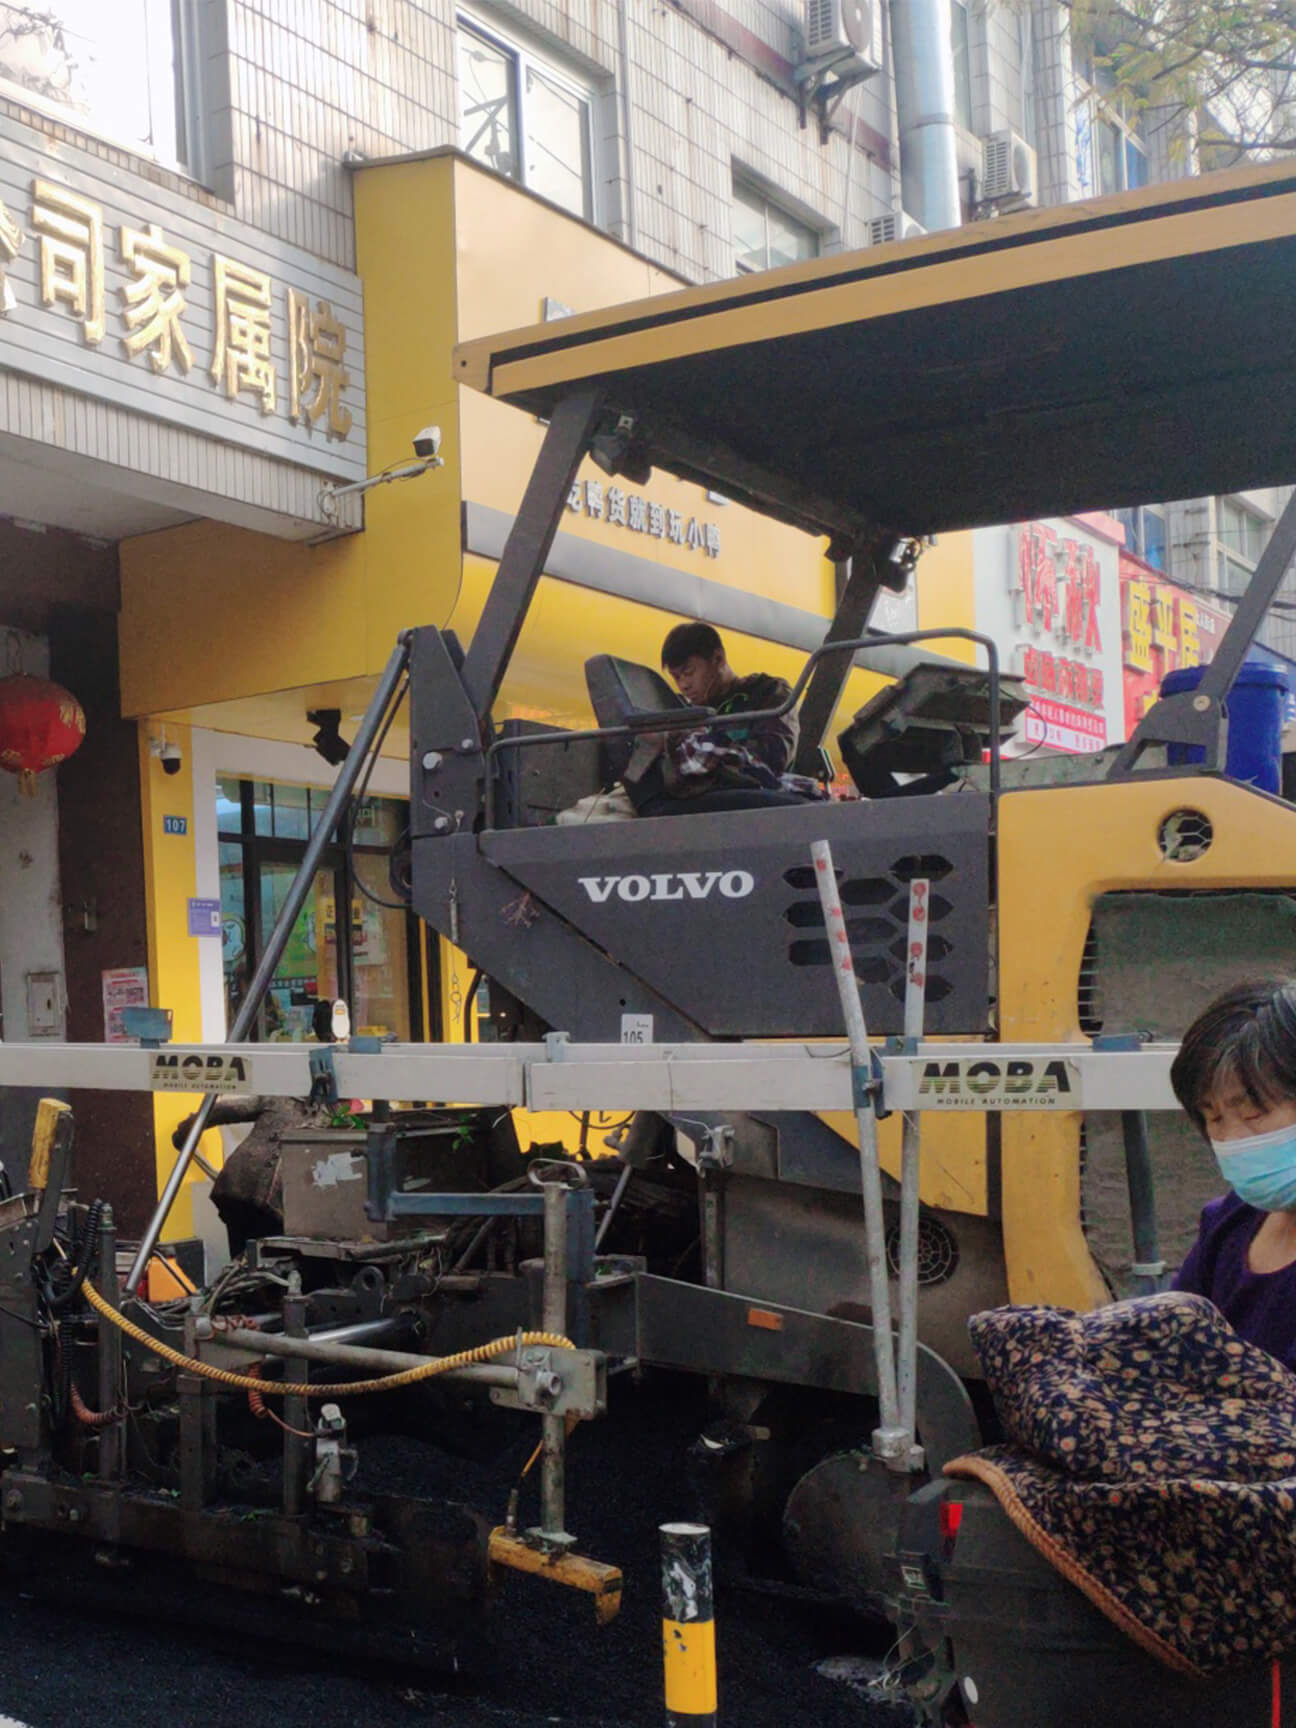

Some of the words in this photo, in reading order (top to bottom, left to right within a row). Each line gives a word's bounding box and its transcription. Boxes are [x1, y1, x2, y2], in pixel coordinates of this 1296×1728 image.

[165, 819, 187, 833] 107
[577, 869, 756, 903] VOLVO
[152, 1055, 246, 1082] MOBA
[919, 1061, 1071, 1094] MOBA
[937, 1097, 976, 1105] MOBILE
[981, 1097, 1056, 1105] AUTOMATION
